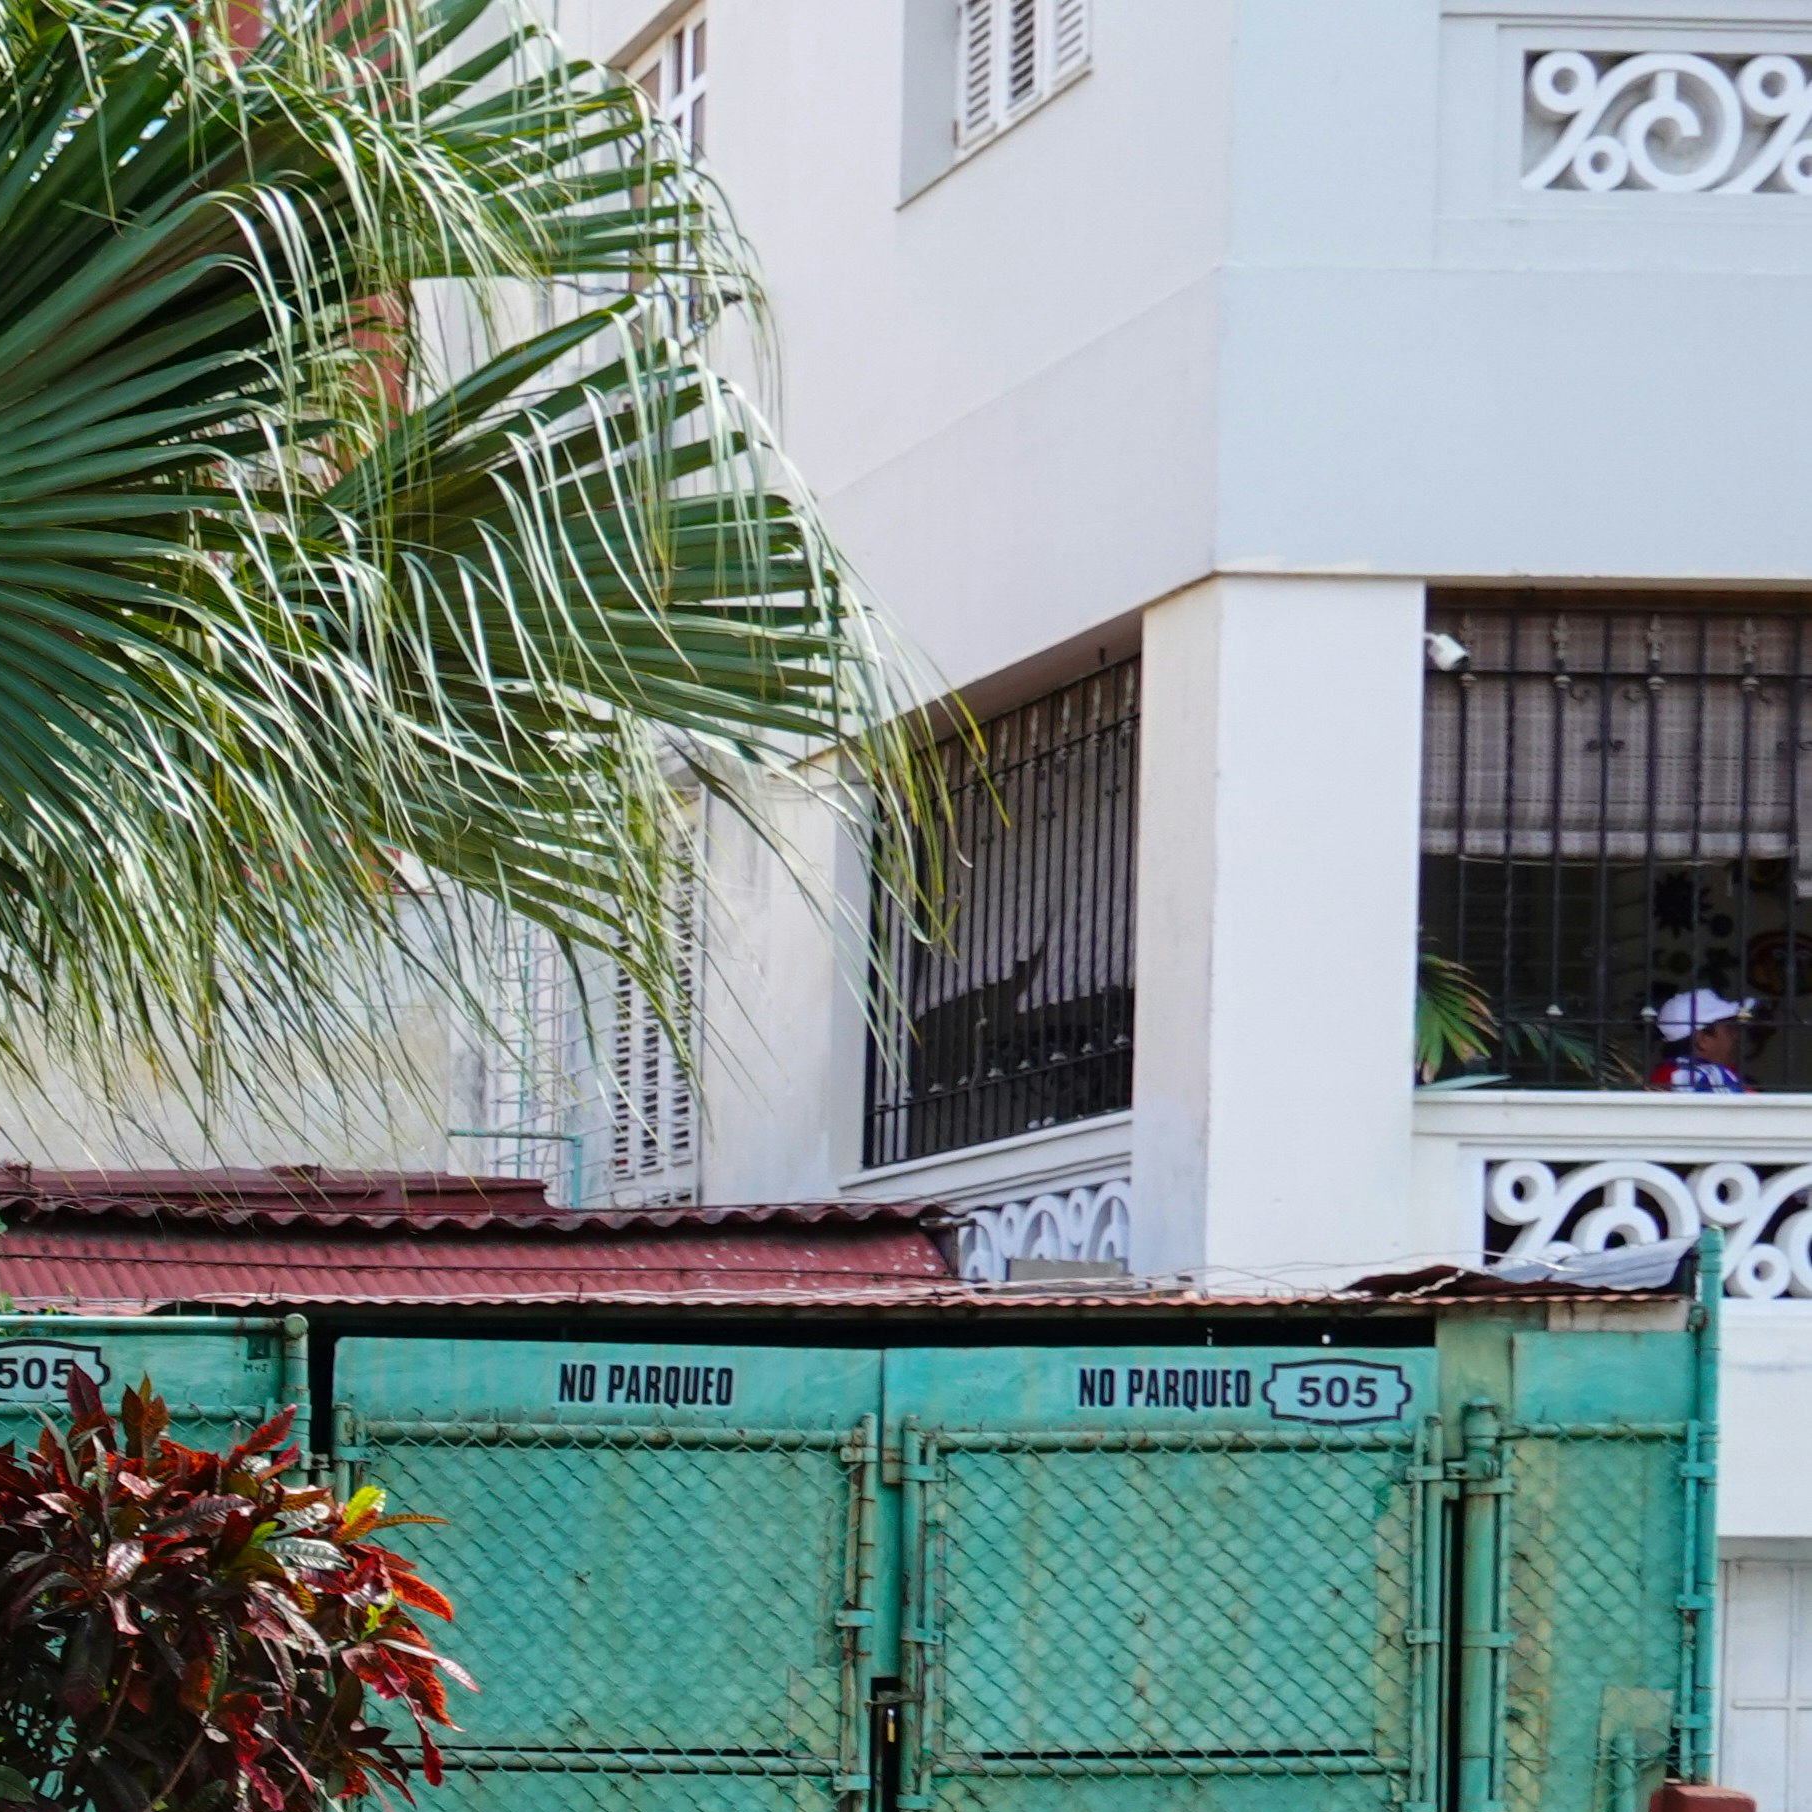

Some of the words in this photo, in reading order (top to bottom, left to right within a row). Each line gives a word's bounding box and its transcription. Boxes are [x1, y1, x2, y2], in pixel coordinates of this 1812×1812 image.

[559, 1363, 596, 1402] NO
[607, 1364, 733, 1410] PARQUEO
[1078, 1368, 1115, 1407] NO
[1127, 1369, 1251, 1412] PARQUEO
[1297, 1376, 1378, 1408] 505
